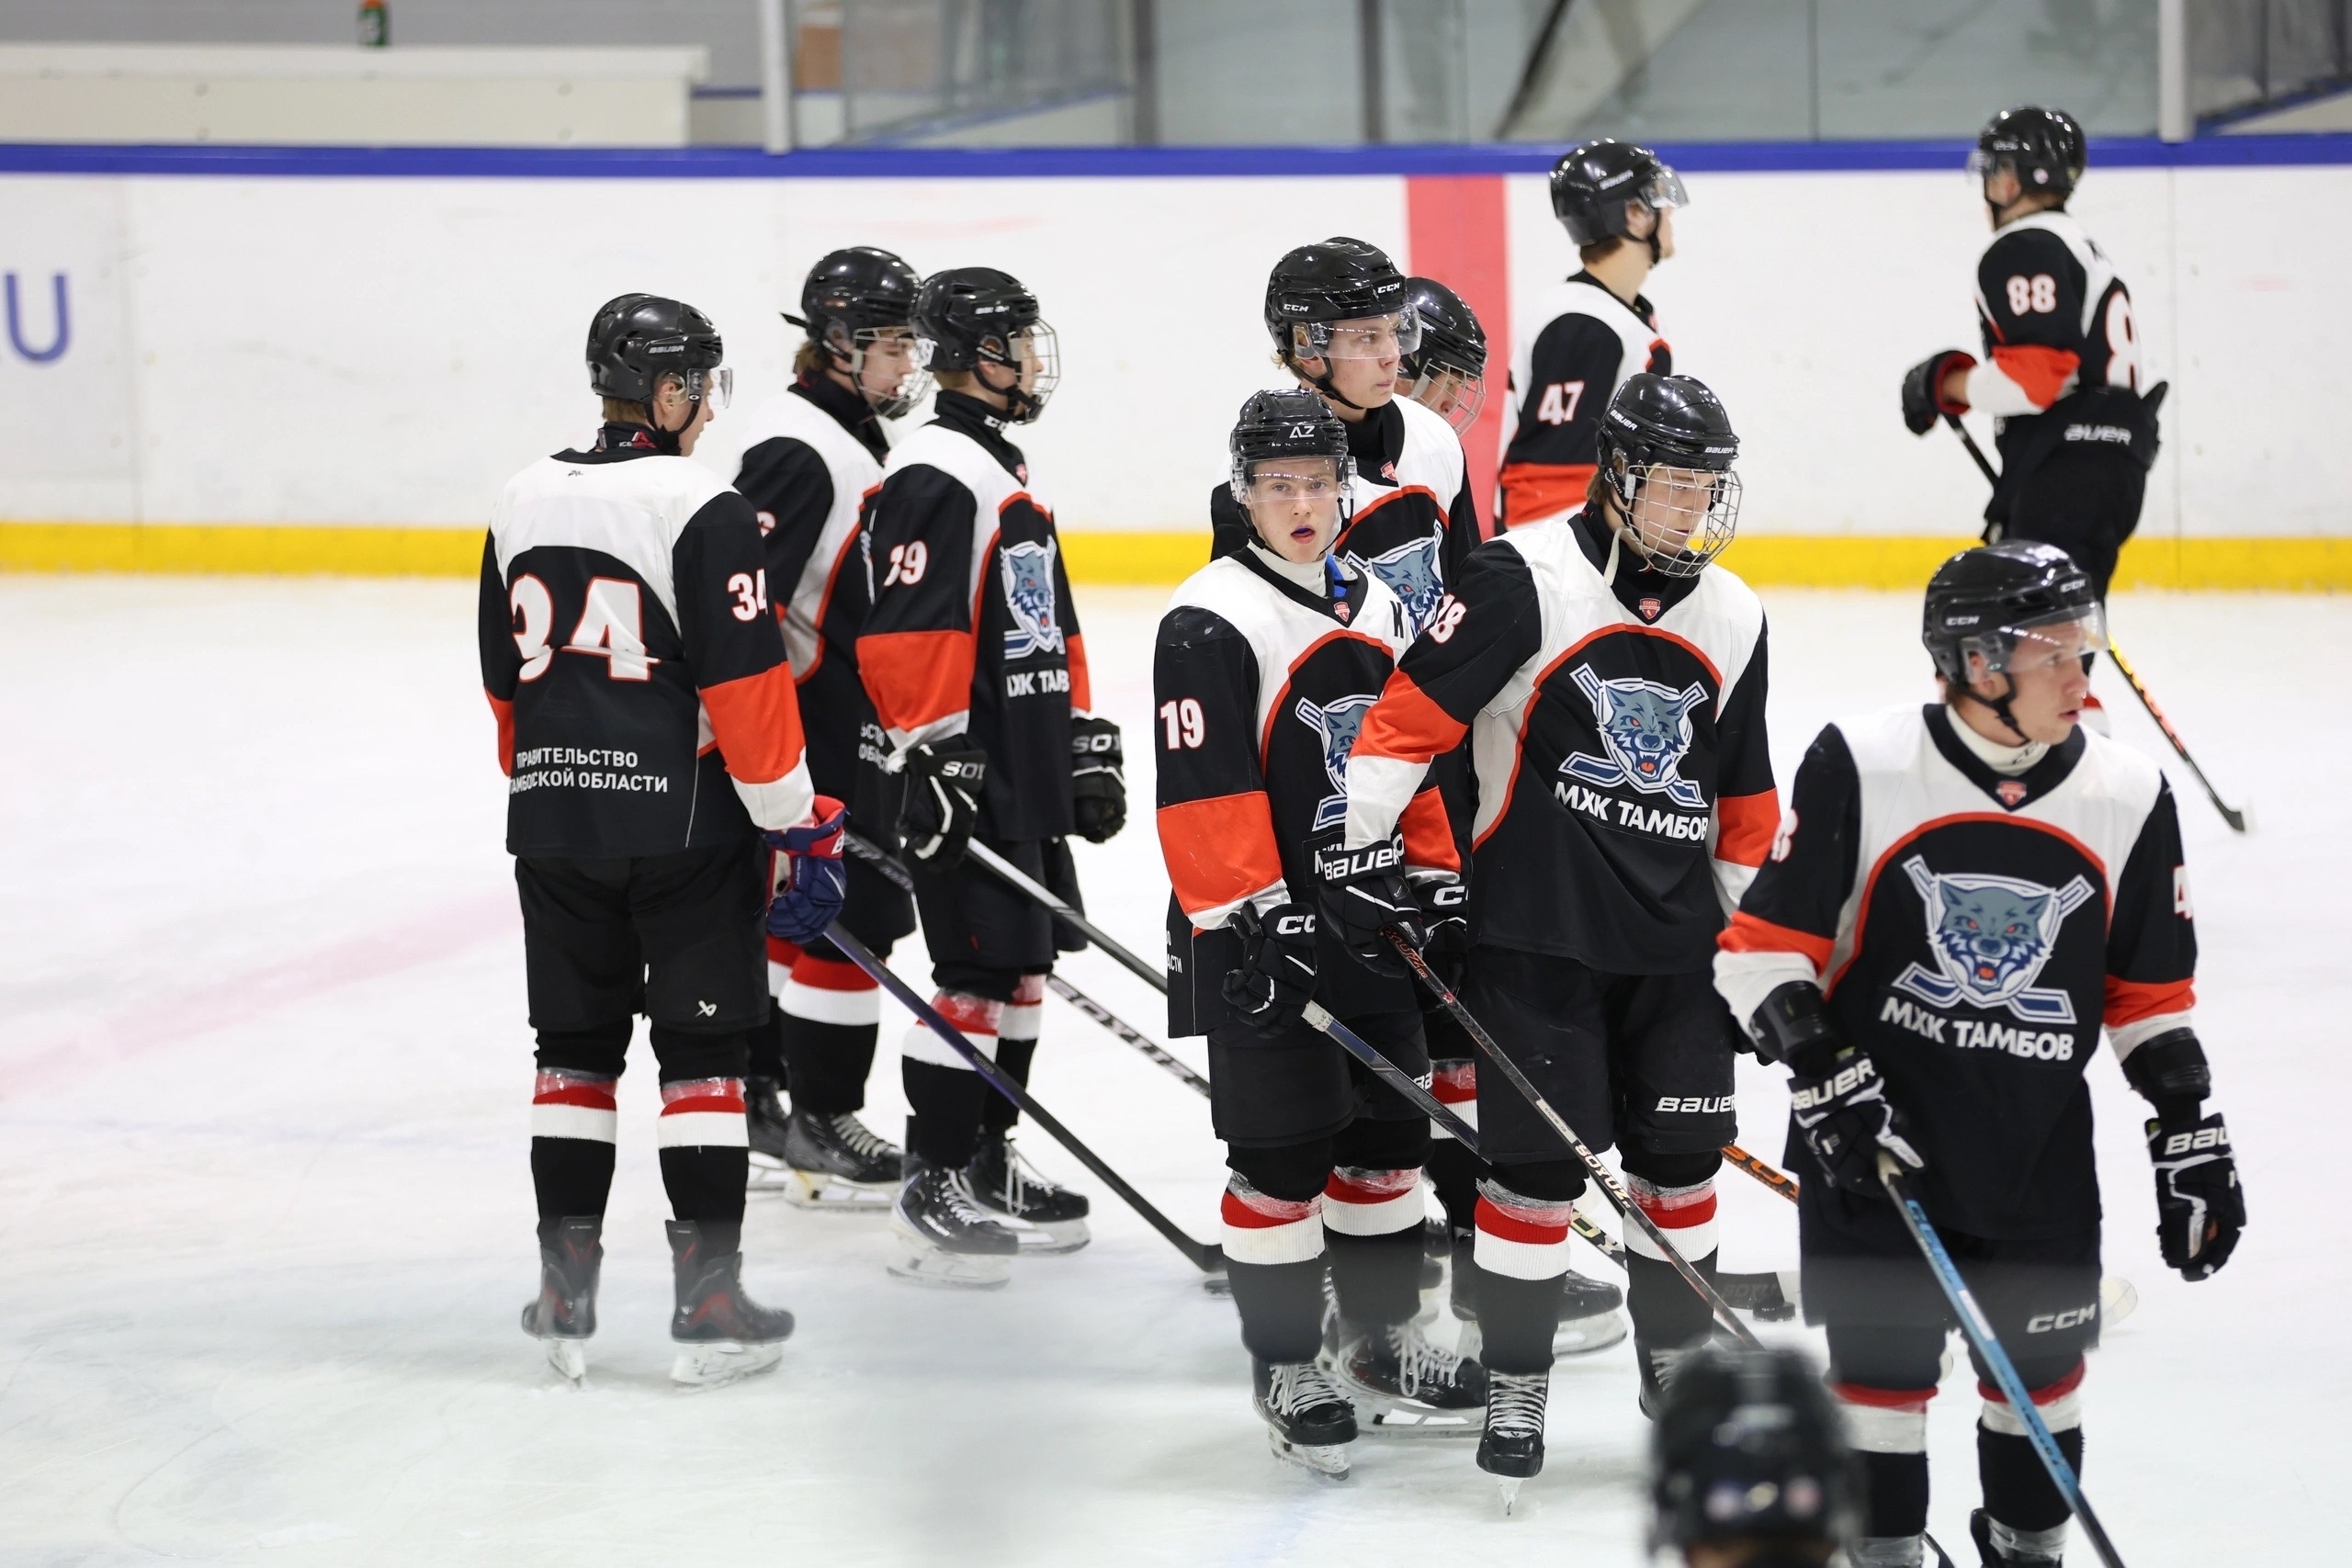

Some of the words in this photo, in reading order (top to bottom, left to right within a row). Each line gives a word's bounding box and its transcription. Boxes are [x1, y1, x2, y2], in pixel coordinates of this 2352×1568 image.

[1378, 282, 1400, 294] CCM
[2006, 274, 2057, 317] 88
[1283, 303, 1309, 312] CCM
[1537, 378, 1586, 426] 47
[1610, 409, 1638, 432] BAUER
[1704, 446, 1735, 455] BAUER
[510, 572, 662, 683] 34
[1159, 698, 1205, 750] 19
[516, 747, 639, 770] ПРАВИТЕЛЬСТВО
[578, 772, 668, 793] ОБЛАСТИ
[1554, 781, 1612, 821] МХК
[1617, 800, 1709, 841] ТАМБОВ
[1880, 996, 1948, 1044] МХК
[1952, 1020, 2075, 1061] ТАМБОВ
[1575, 1144, 1631, 1201] SOYUZ
[2027, 1303, 2098, 1334] CCM
